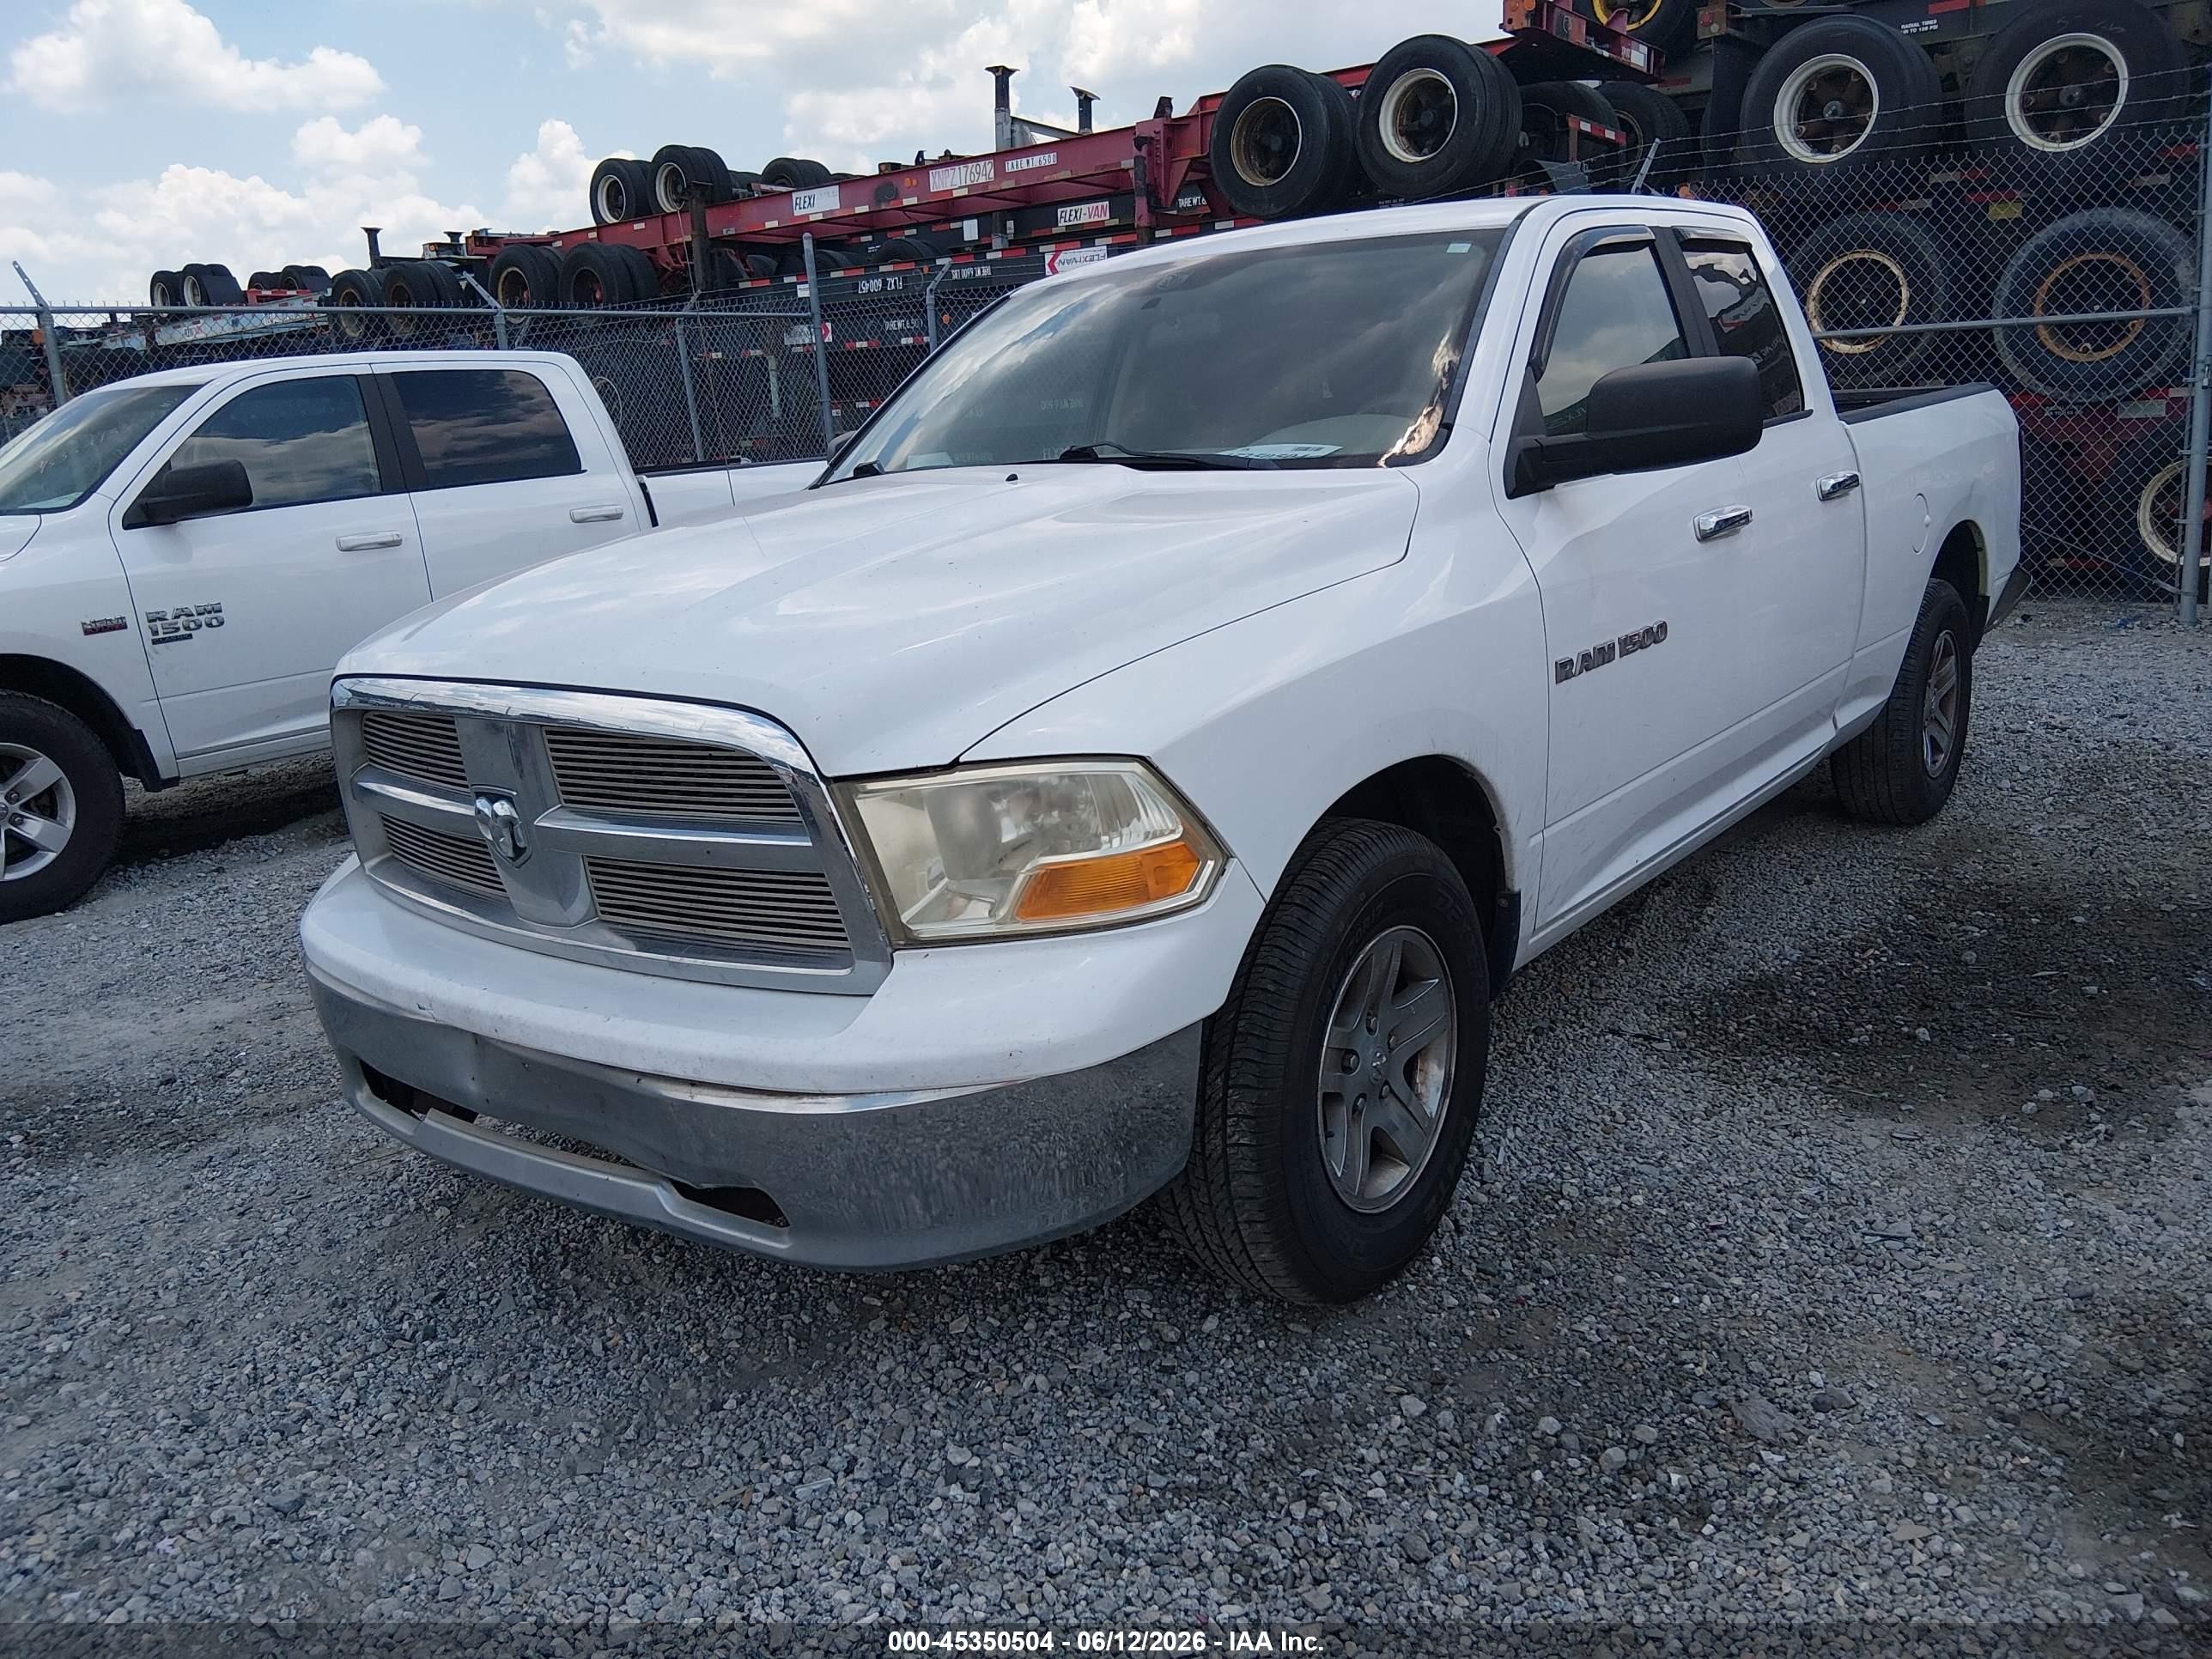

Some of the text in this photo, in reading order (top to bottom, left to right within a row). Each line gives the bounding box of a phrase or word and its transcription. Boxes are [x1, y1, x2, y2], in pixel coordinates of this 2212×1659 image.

[1006, 161, 1024, 170] TARE
[1038, 154, 1056, 166] 6500
[932, 161, 994, 191] XNPZ176942
[794, 193, 816, 210] FLEXI
[1059, 204, 1109, 224] FLEXI-VAN
[858, 276, 903, 294] FLXZ 600457
[145, 602, 222, 623] RAM
[148, 615, 225, 637] 1500
[1555, 620, 1668, 684] RAM 1500
